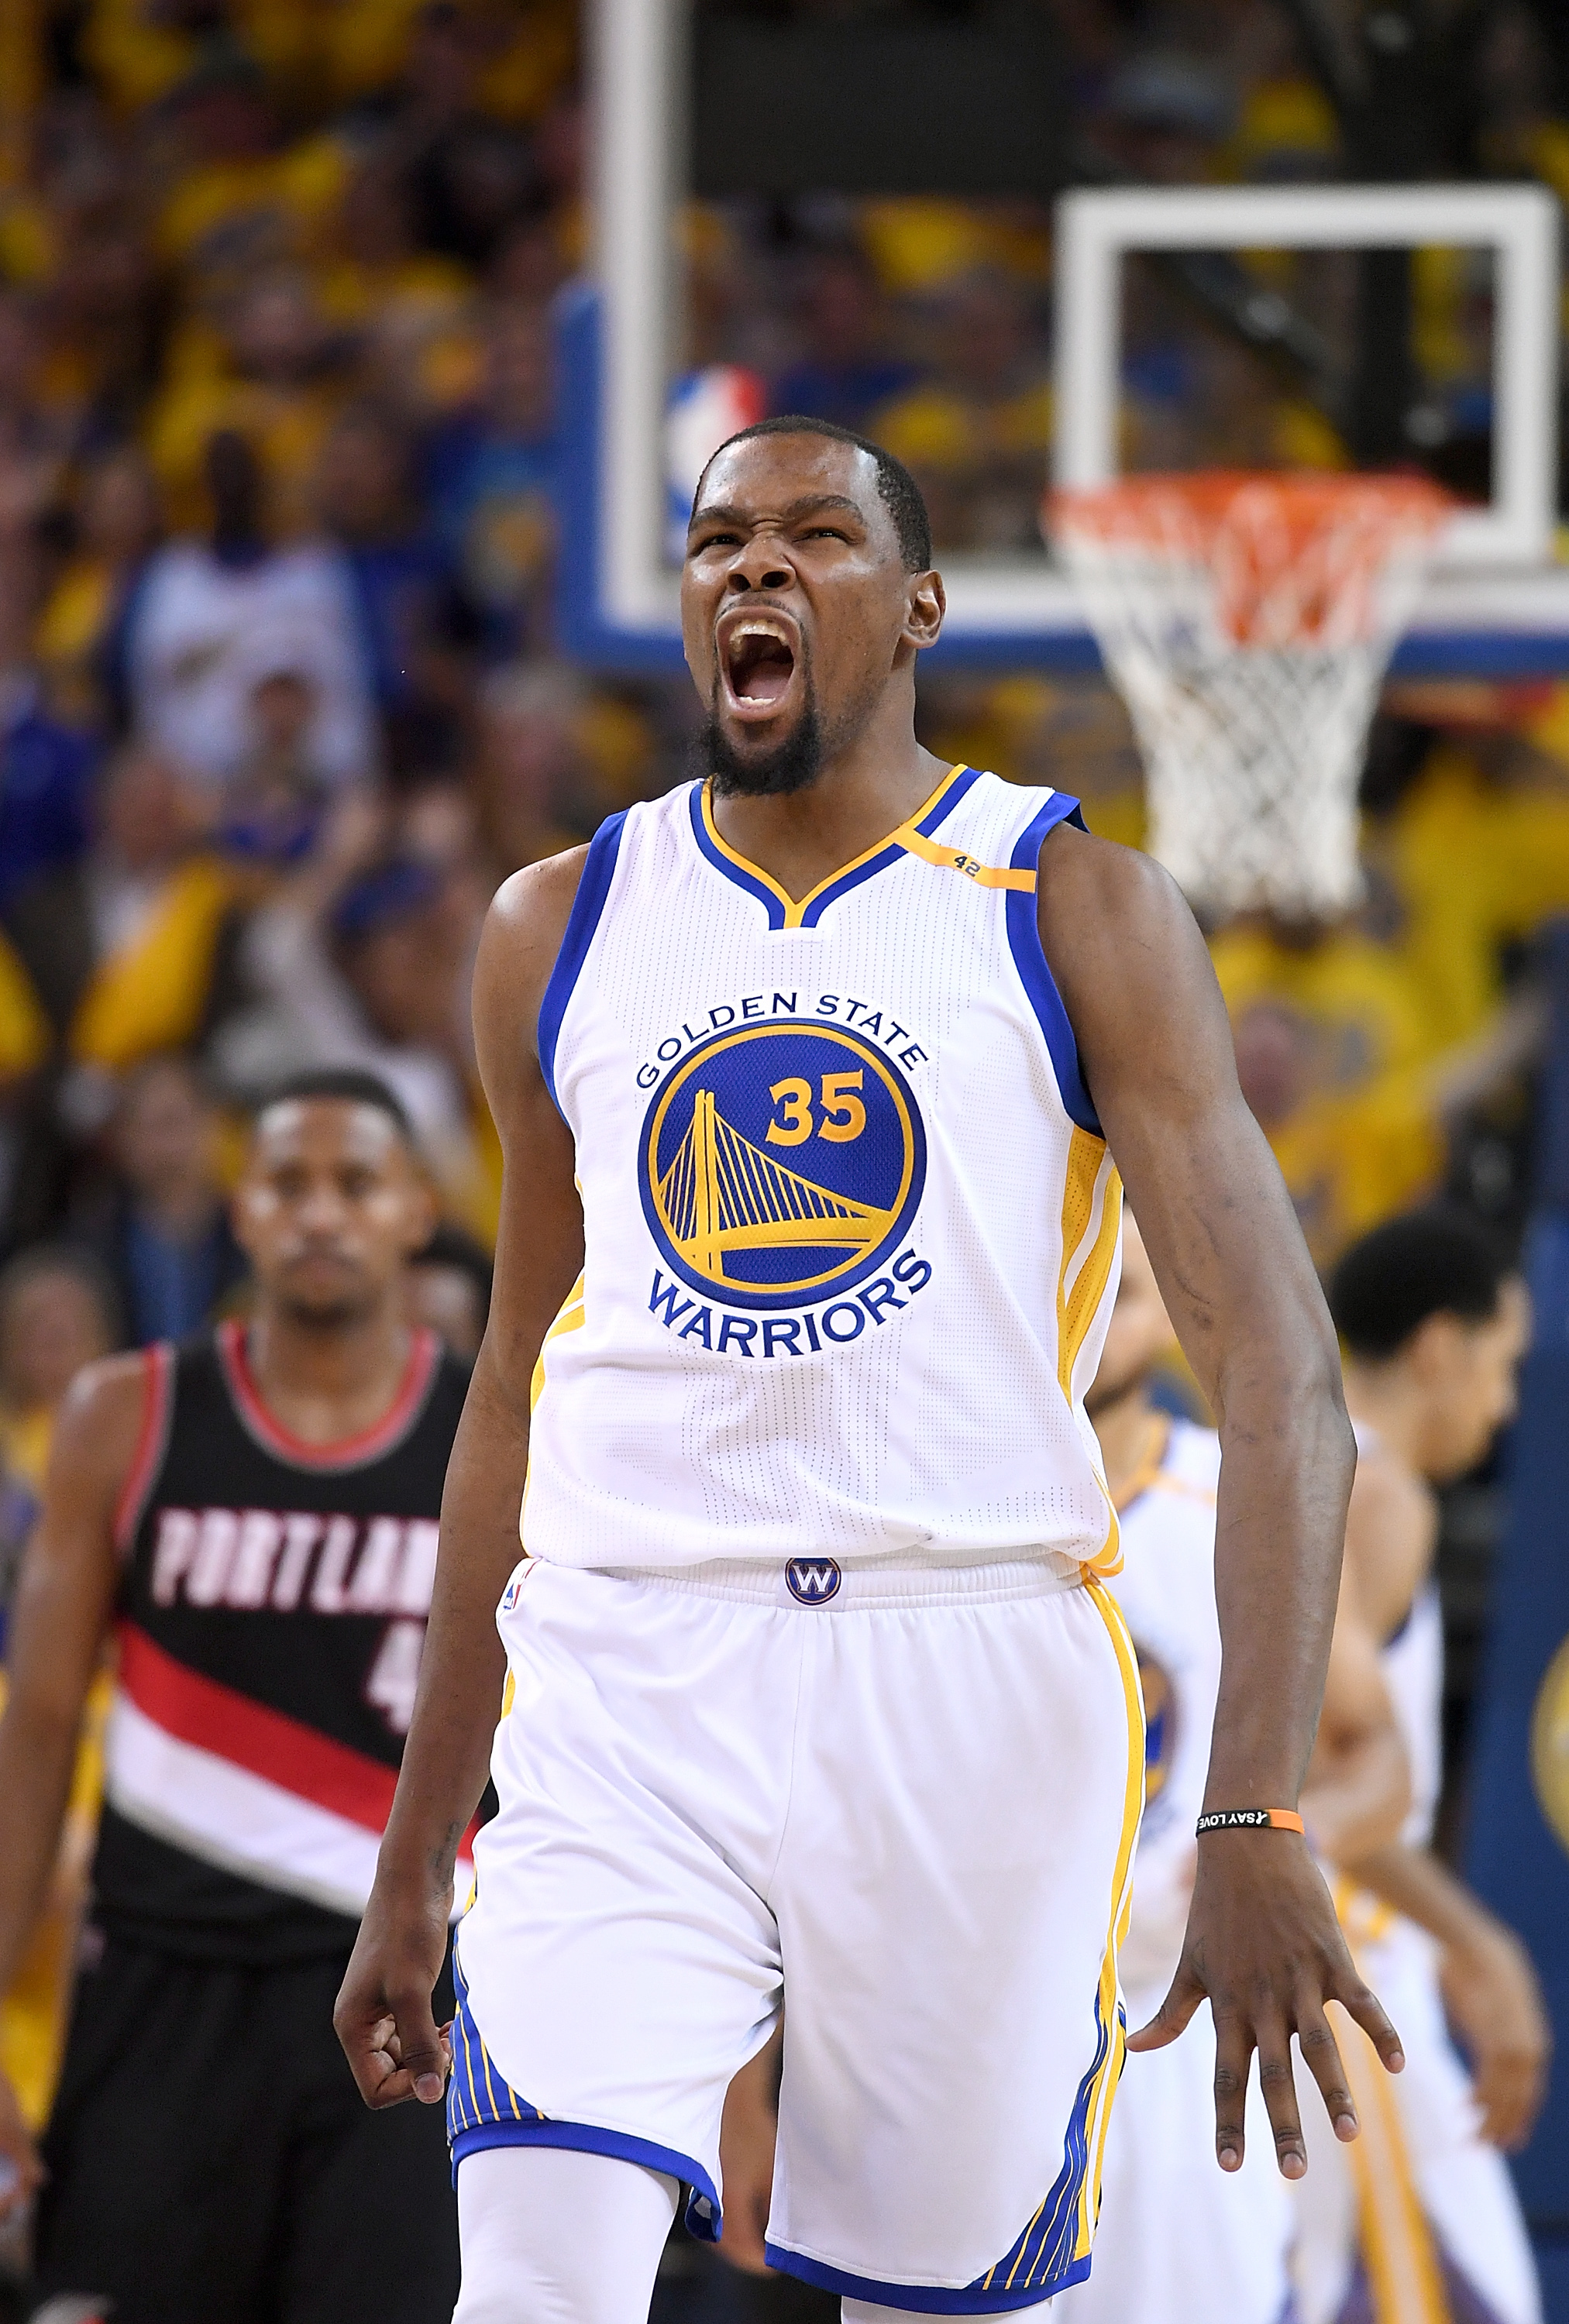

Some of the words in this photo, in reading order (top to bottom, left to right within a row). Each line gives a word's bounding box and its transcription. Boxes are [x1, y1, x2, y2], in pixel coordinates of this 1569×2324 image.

[954, 855, 981, 878] 42
[635, 992, 798, 1089] GOLDEN
[814, 994, 930, 1072] STATE
[765, 1068, 867, 1147] 35
[647, 1248, 932, 1359] WARRIORS
[791, 1563, 834, 1593] W
[1199, 1814, 1227, 1829] LOVE
[1228, 1813, 1256, 1824] SAY
